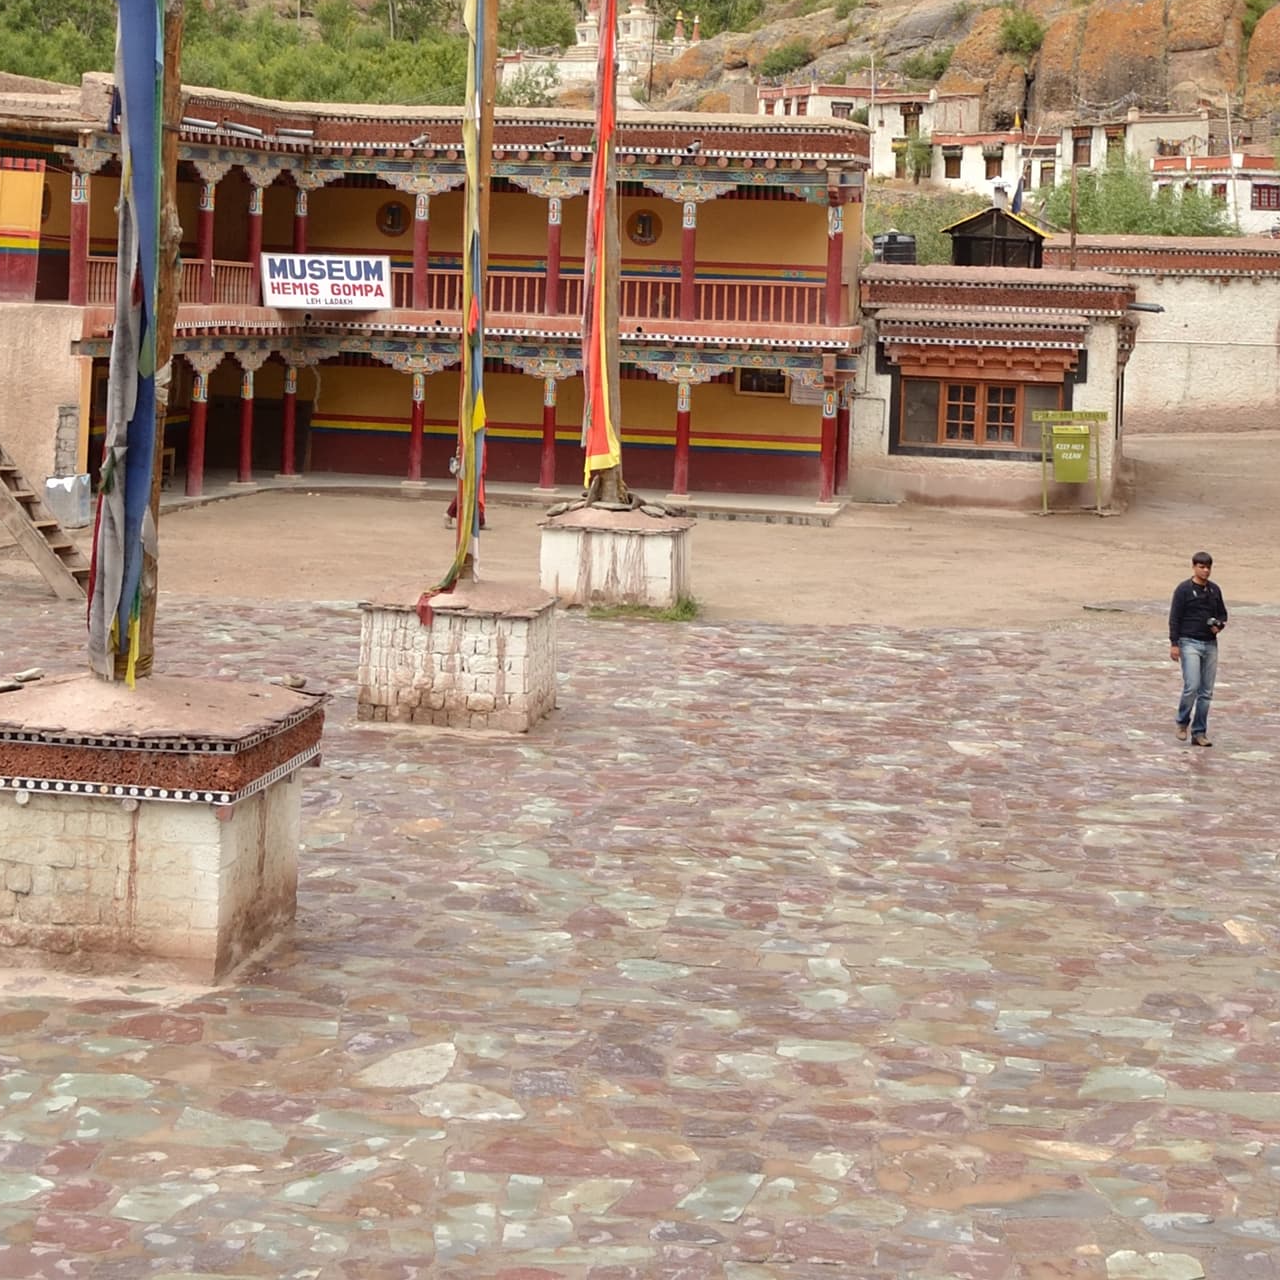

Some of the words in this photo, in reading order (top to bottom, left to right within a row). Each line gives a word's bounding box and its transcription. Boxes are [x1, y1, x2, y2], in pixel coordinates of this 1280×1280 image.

[268, 258, 383, 281] MUSEUM
[271, 282, 320, 296] HEMIS
[330, 283, 384, 297] GOMPA
